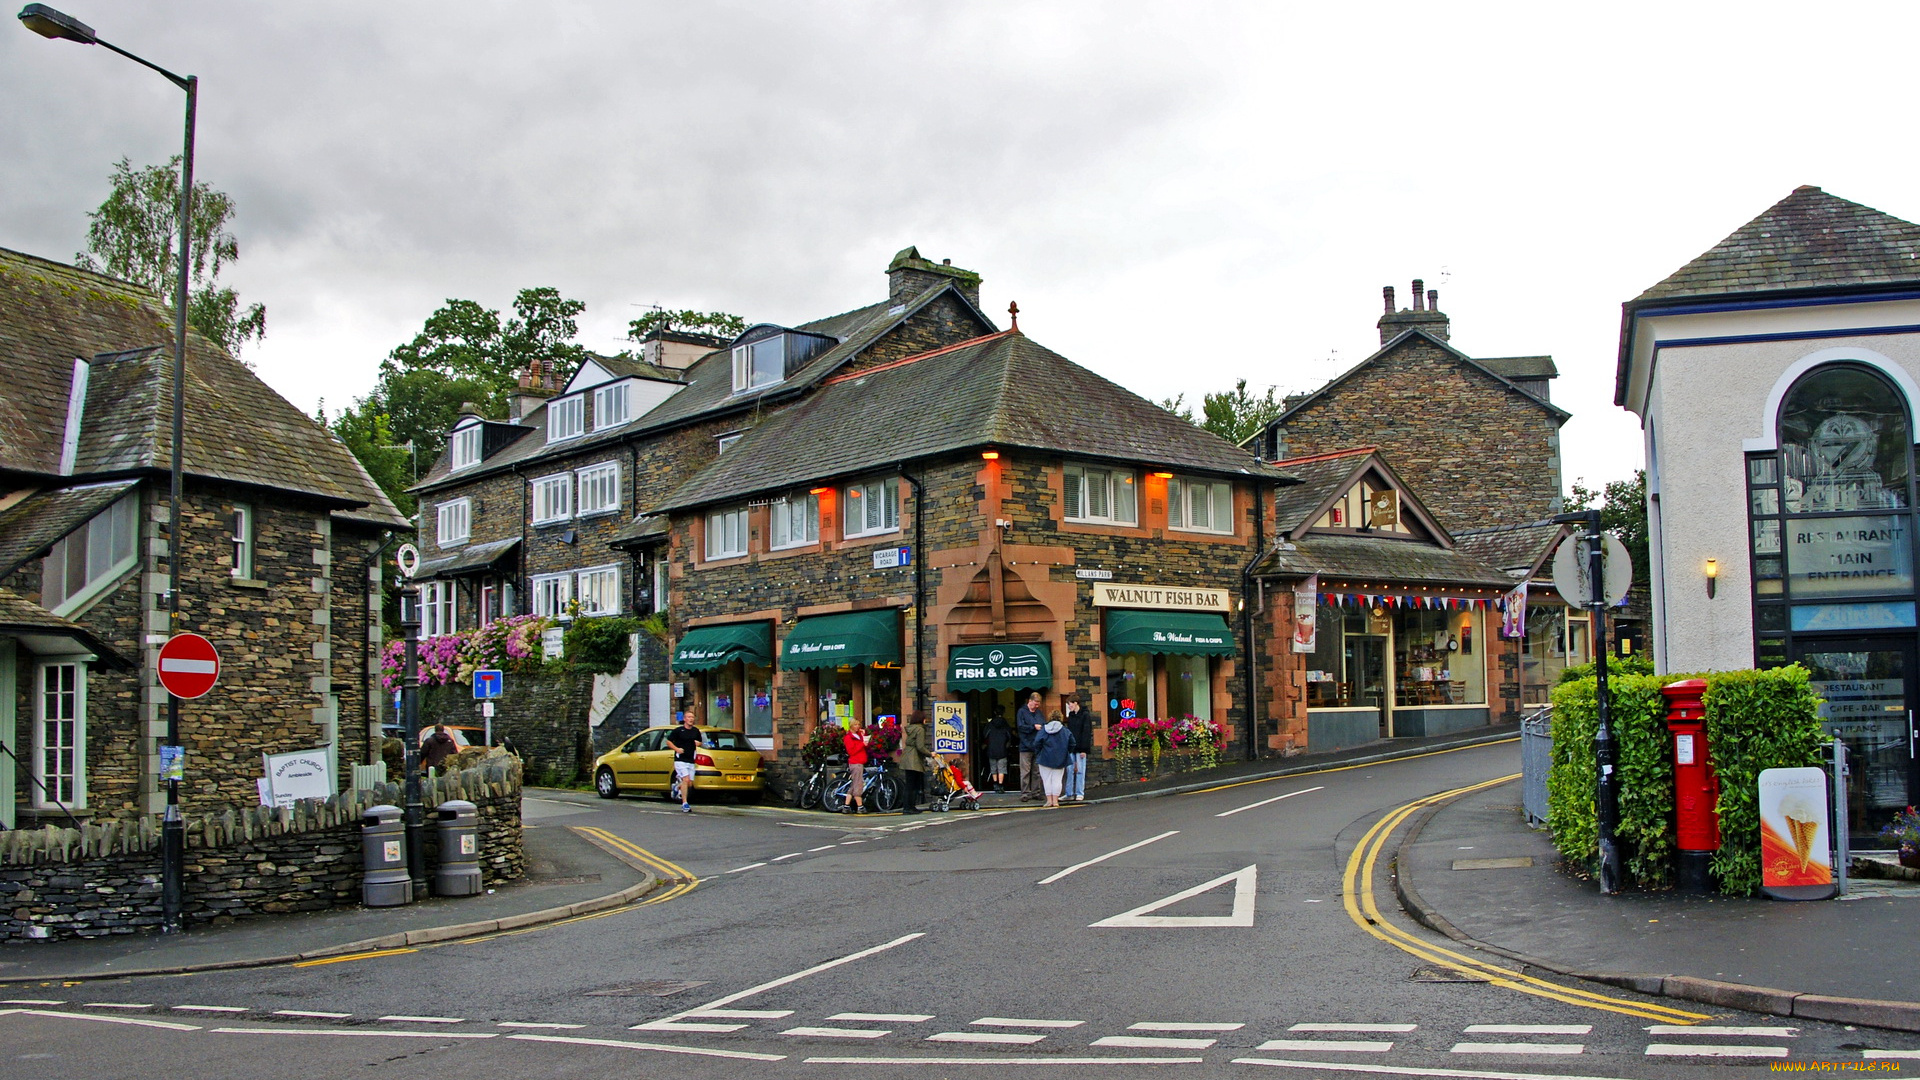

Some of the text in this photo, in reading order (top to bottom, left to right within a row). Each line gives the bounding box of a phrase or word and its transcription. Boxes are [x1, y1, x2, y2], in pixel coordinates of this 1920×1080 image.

[1797, 528, 1903, 544] RESTAURANT
[874, 550, 897, 560] VICARAGE
[1830, 552, 1873, 565] MAIN
[880, 558, 893, 566] ROAD
[1808, 568, 1896, 581] ENTRANCE
[1105, 588, 1220, 607] WALNUT FISH BAR
[1153, 631, 1167, 642] The
[789, 643, 801, 654] The
[955, 666, 1038, 679] FISH & CHIPS
[1823, 683, 1886, 692] RESTAURANT
[1120, 698, 1136, 709] FISH
[1829, 704, 1854, 713] CAFE
[1861, 704, 1881, 712] BAR
[936, 705, 962, 715] FISH
[935, 729, 965, 739] CHIPS
[938, 739, 963, 750] OPEN
[275, 758, 324, 777] BAPTIST CHURCH
[288, 771, 313, 779] Ambleside
